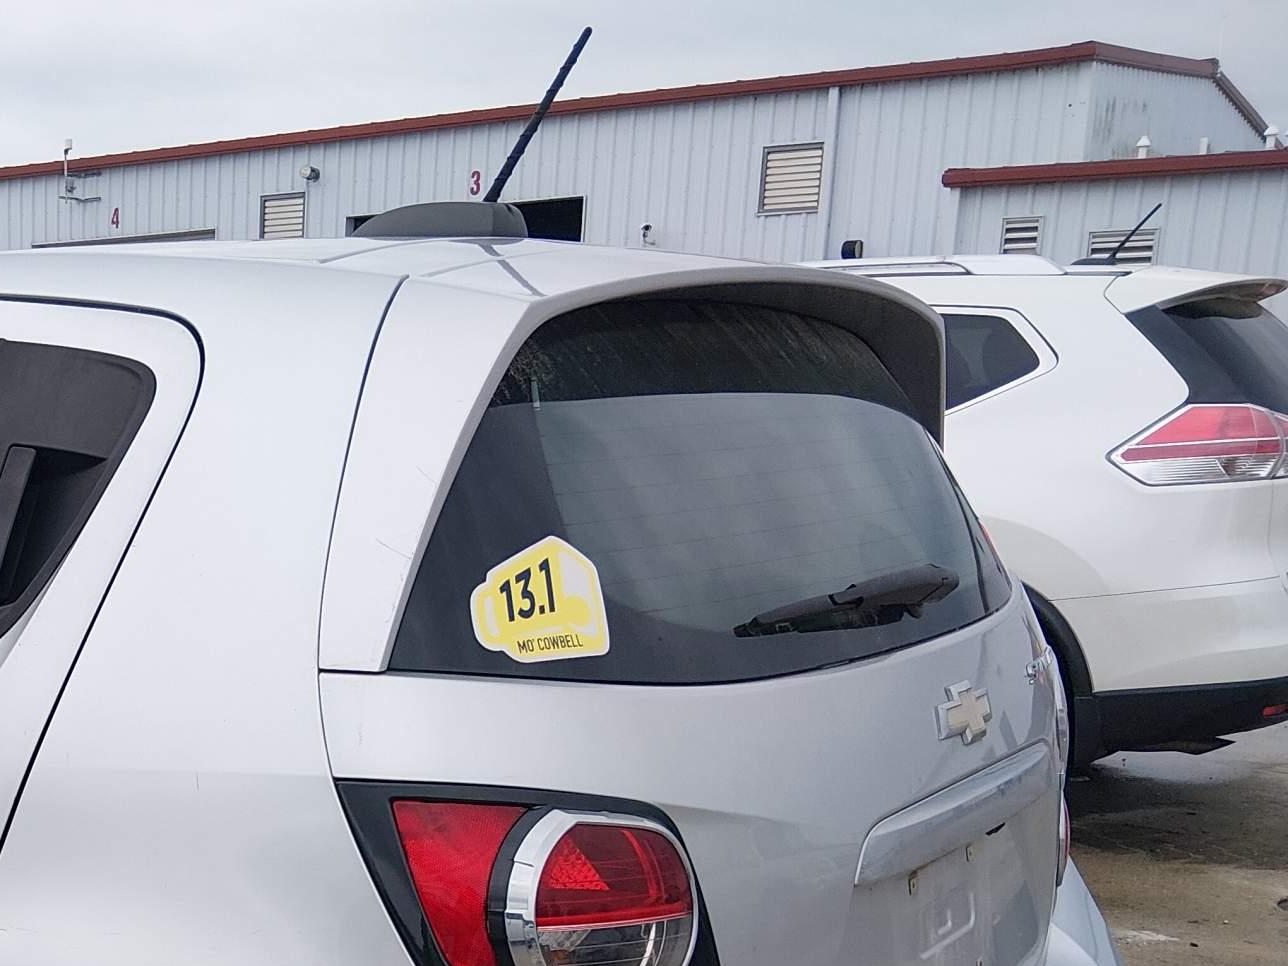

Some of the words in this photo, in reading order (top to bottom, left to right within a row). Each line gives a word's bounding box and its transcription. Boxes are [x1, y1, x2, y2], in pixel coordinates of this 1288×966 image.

[469, 170, 480, 195] 3
[110, 207, 120, 229] 4
[499, 557, 556, 622] 13.1
[517, 639, 535, 654] MO'
[537, 634, 584, 651] COWBELL
